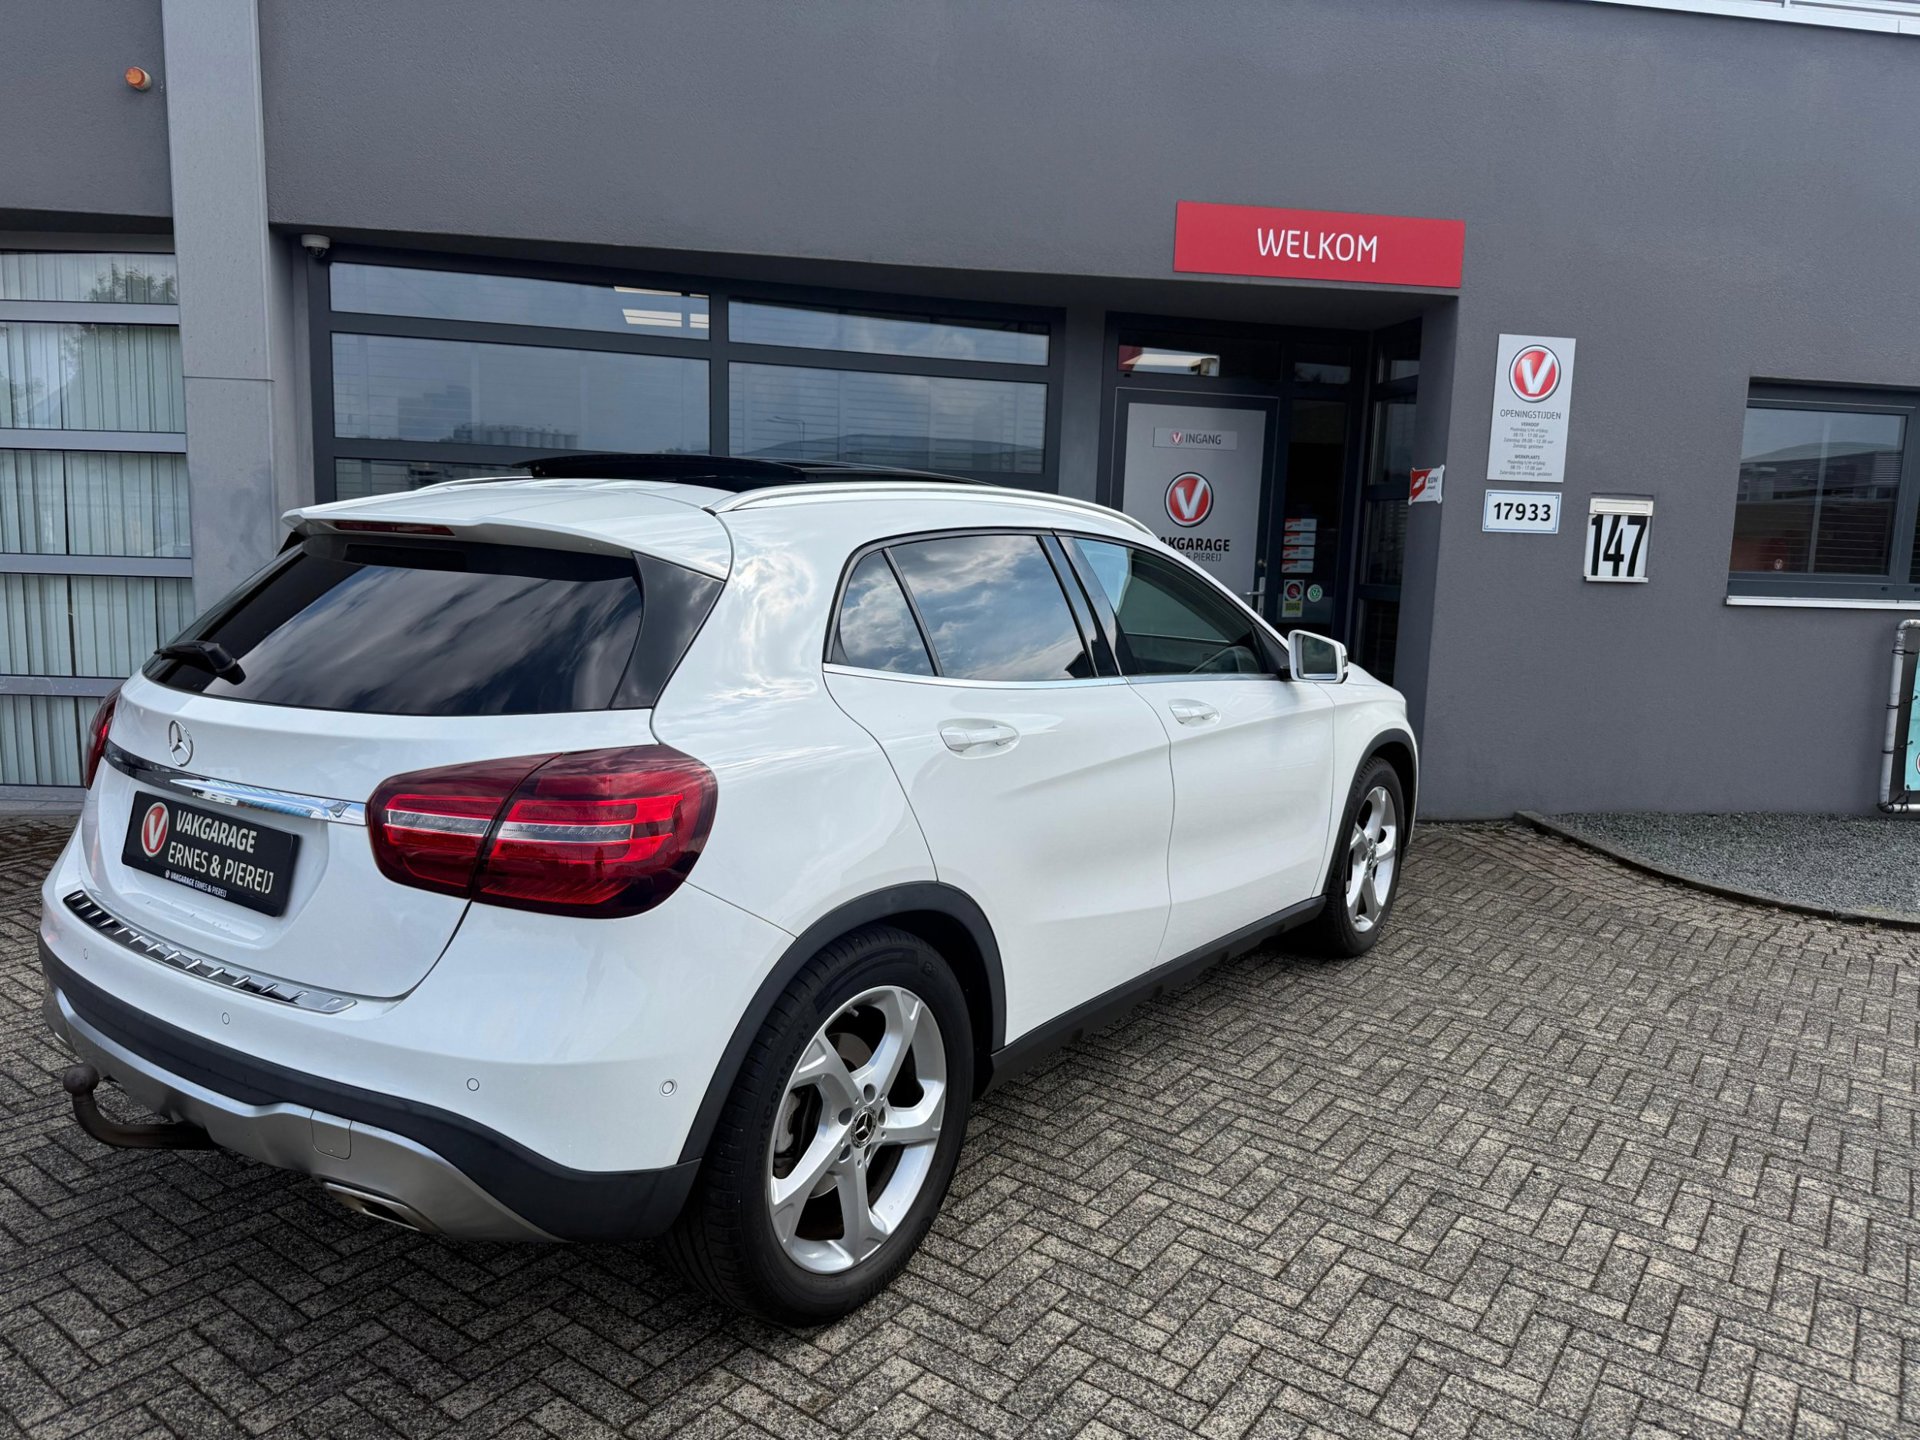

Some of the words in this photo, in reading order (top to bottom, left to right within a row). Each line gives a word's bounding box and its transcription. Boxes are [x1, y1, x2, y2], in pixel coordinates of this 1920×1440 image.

[1257, 227, 1378, 263] WELKOM
[1499, 409, 1562, 420] OPENINGSTIJDEN
[1185, 433, 1222, 445] INGANG
[1493, 502, 1552, 522] 17933
[1158, 536, 1231, 552] AKGARAGE
[1590, 514, 1648, 577] 147
[1193, 552, 1222, 562] PIEREIJ
[176, 809, 258, 854] VAKGARAGE
[168, 841, 209, 873] ERNES
[209, 854, 221, 879] &
[223, 858, 275, 894] PIEREIJ
[170, 871, 195, 888] VAKGARAGE
